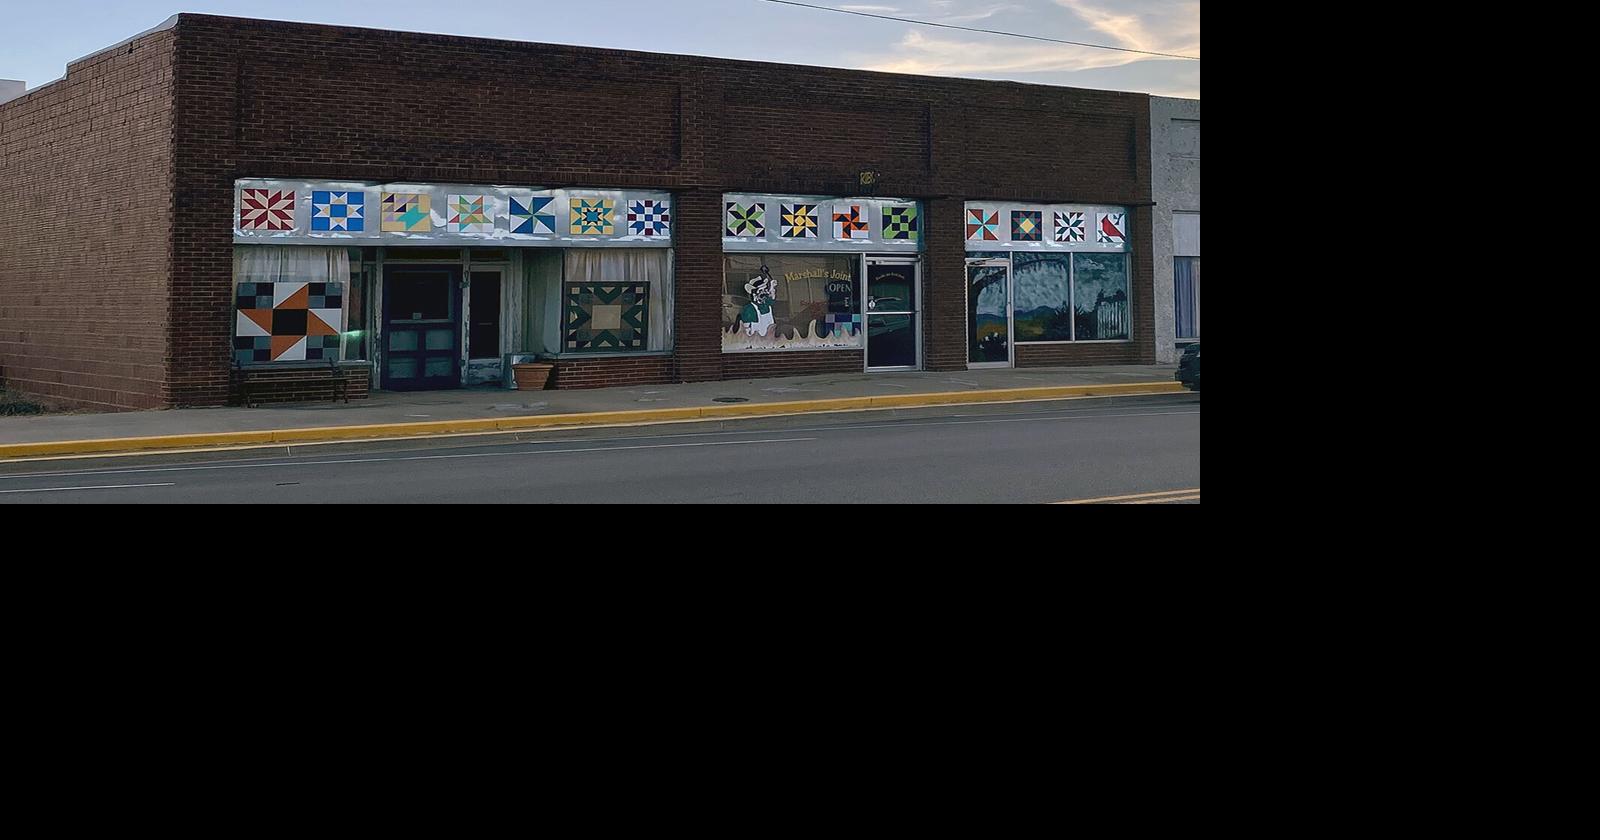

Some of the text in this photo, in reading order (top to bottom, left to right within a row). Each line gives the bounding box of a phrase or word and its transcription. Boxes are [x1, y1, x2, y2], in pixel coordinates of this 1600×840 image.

[784, 268, 851, 282] Marshall's Joint
[829, 283, 851, 292] OPEN
